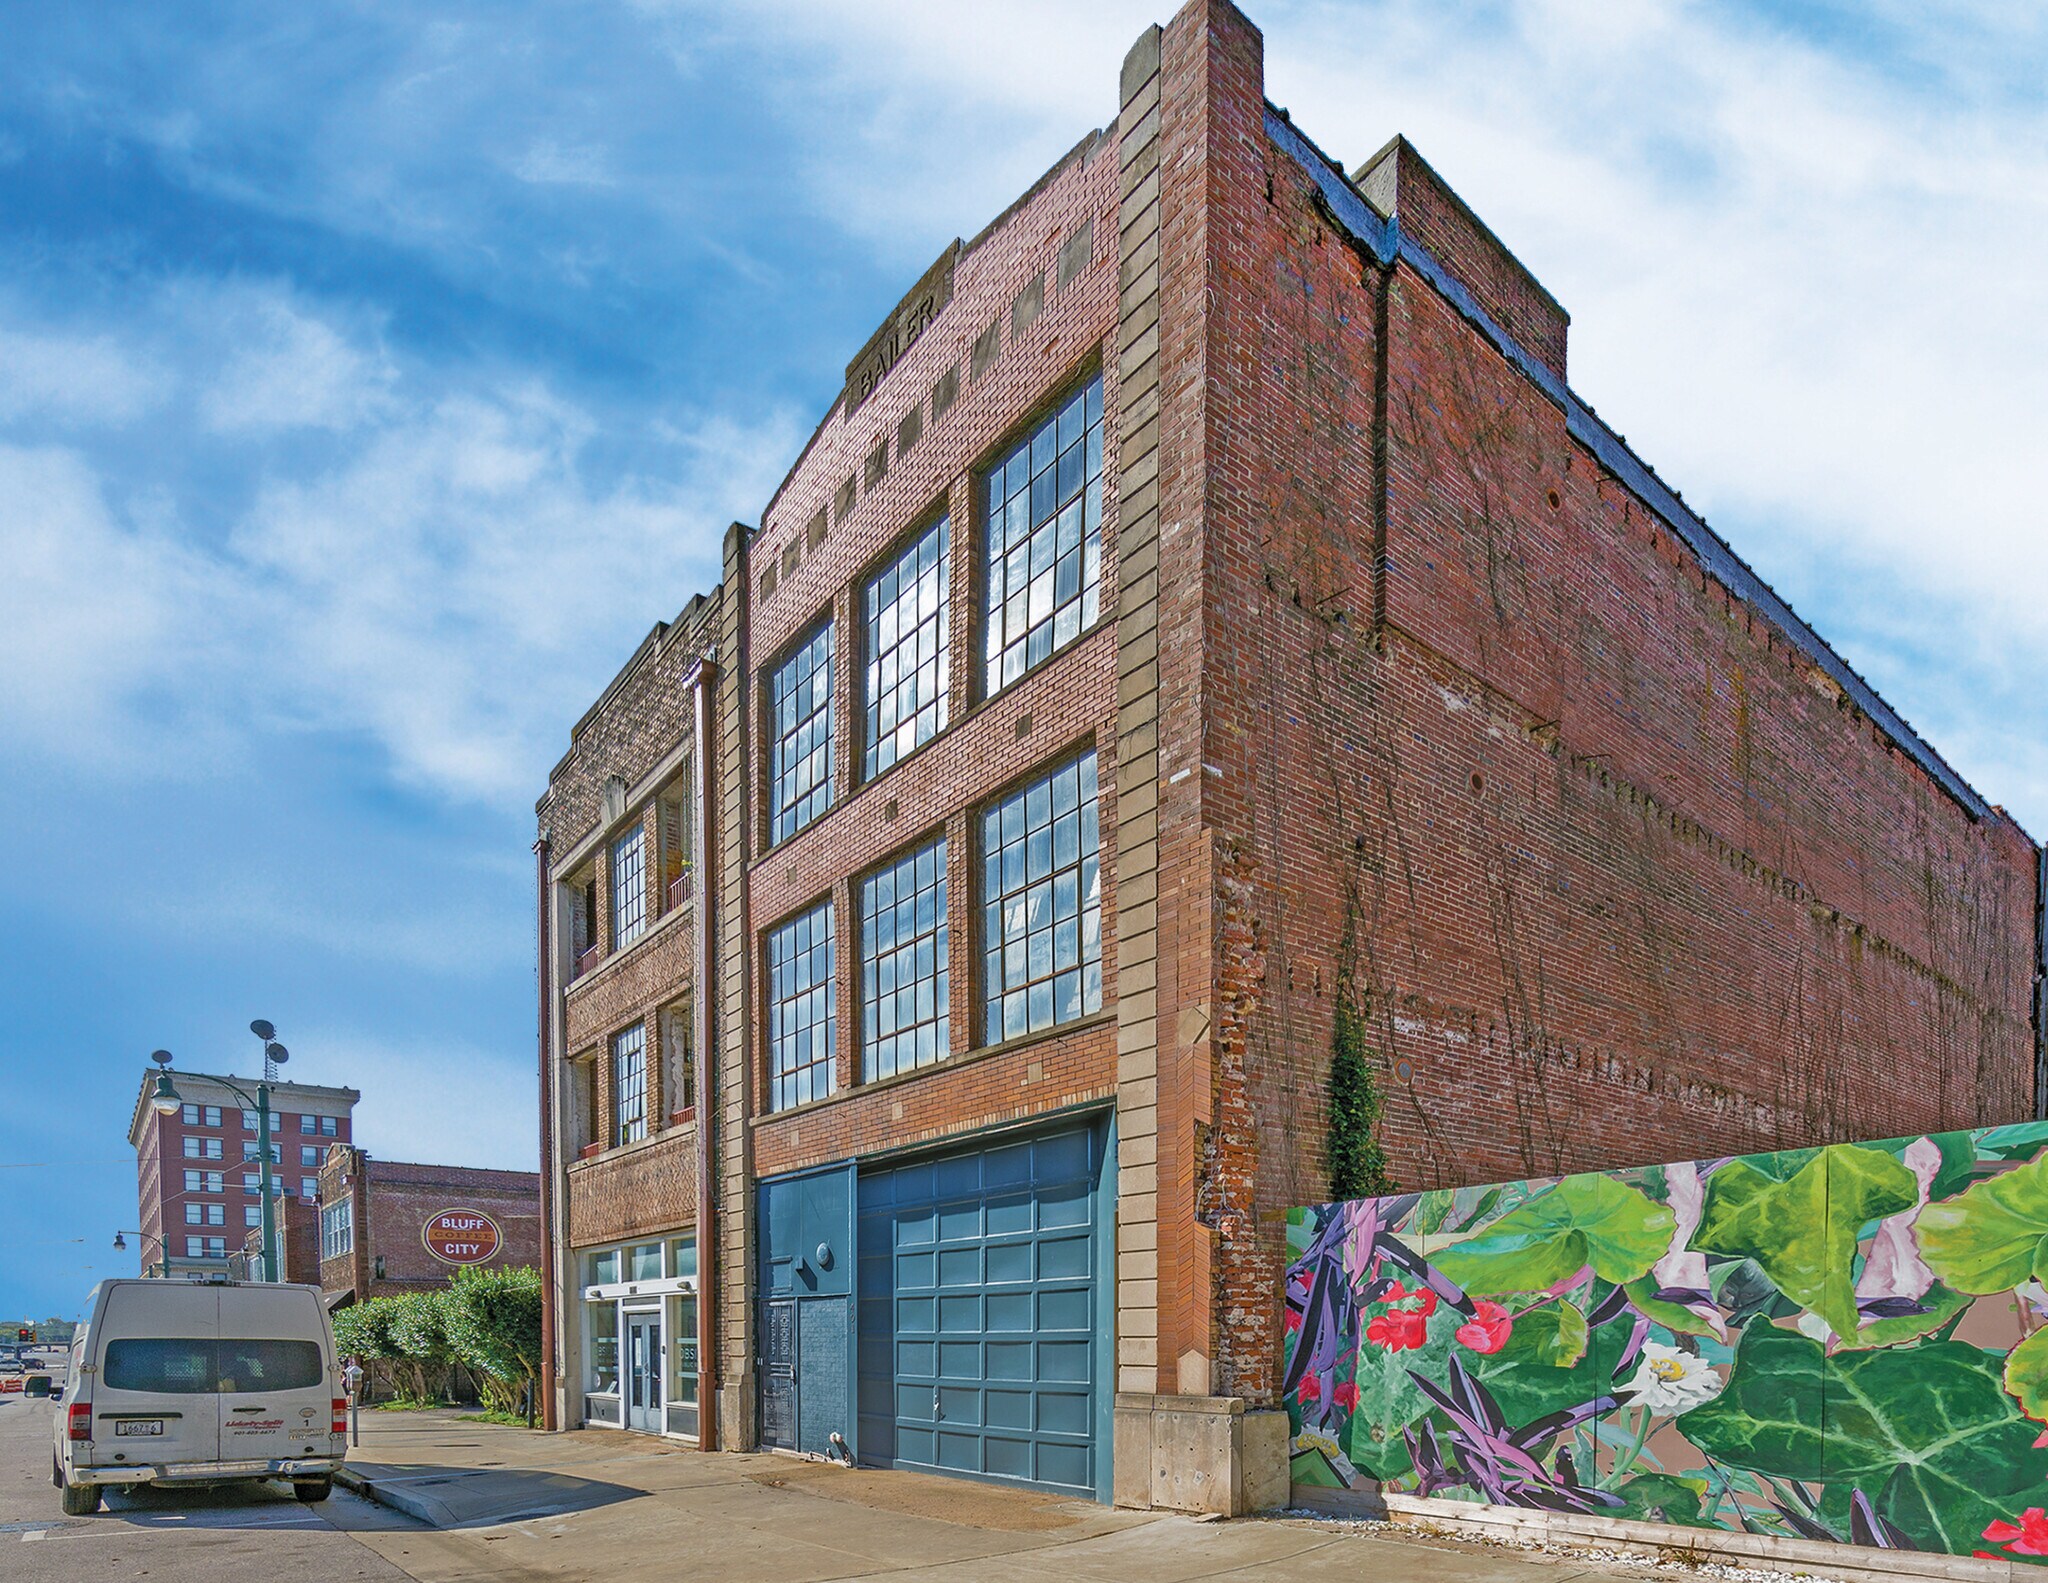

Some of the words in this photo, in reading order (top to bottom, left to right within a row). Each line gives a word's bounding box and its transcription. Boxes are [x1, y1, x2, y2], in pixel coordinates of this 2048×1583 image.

[441, 1218, 484, 1230] BLUFF
[434, 1231, 492, 1240] COFFEE
[445, 1243, 480, 1255] CITY
[303, 1419, 310, 1427] 1
